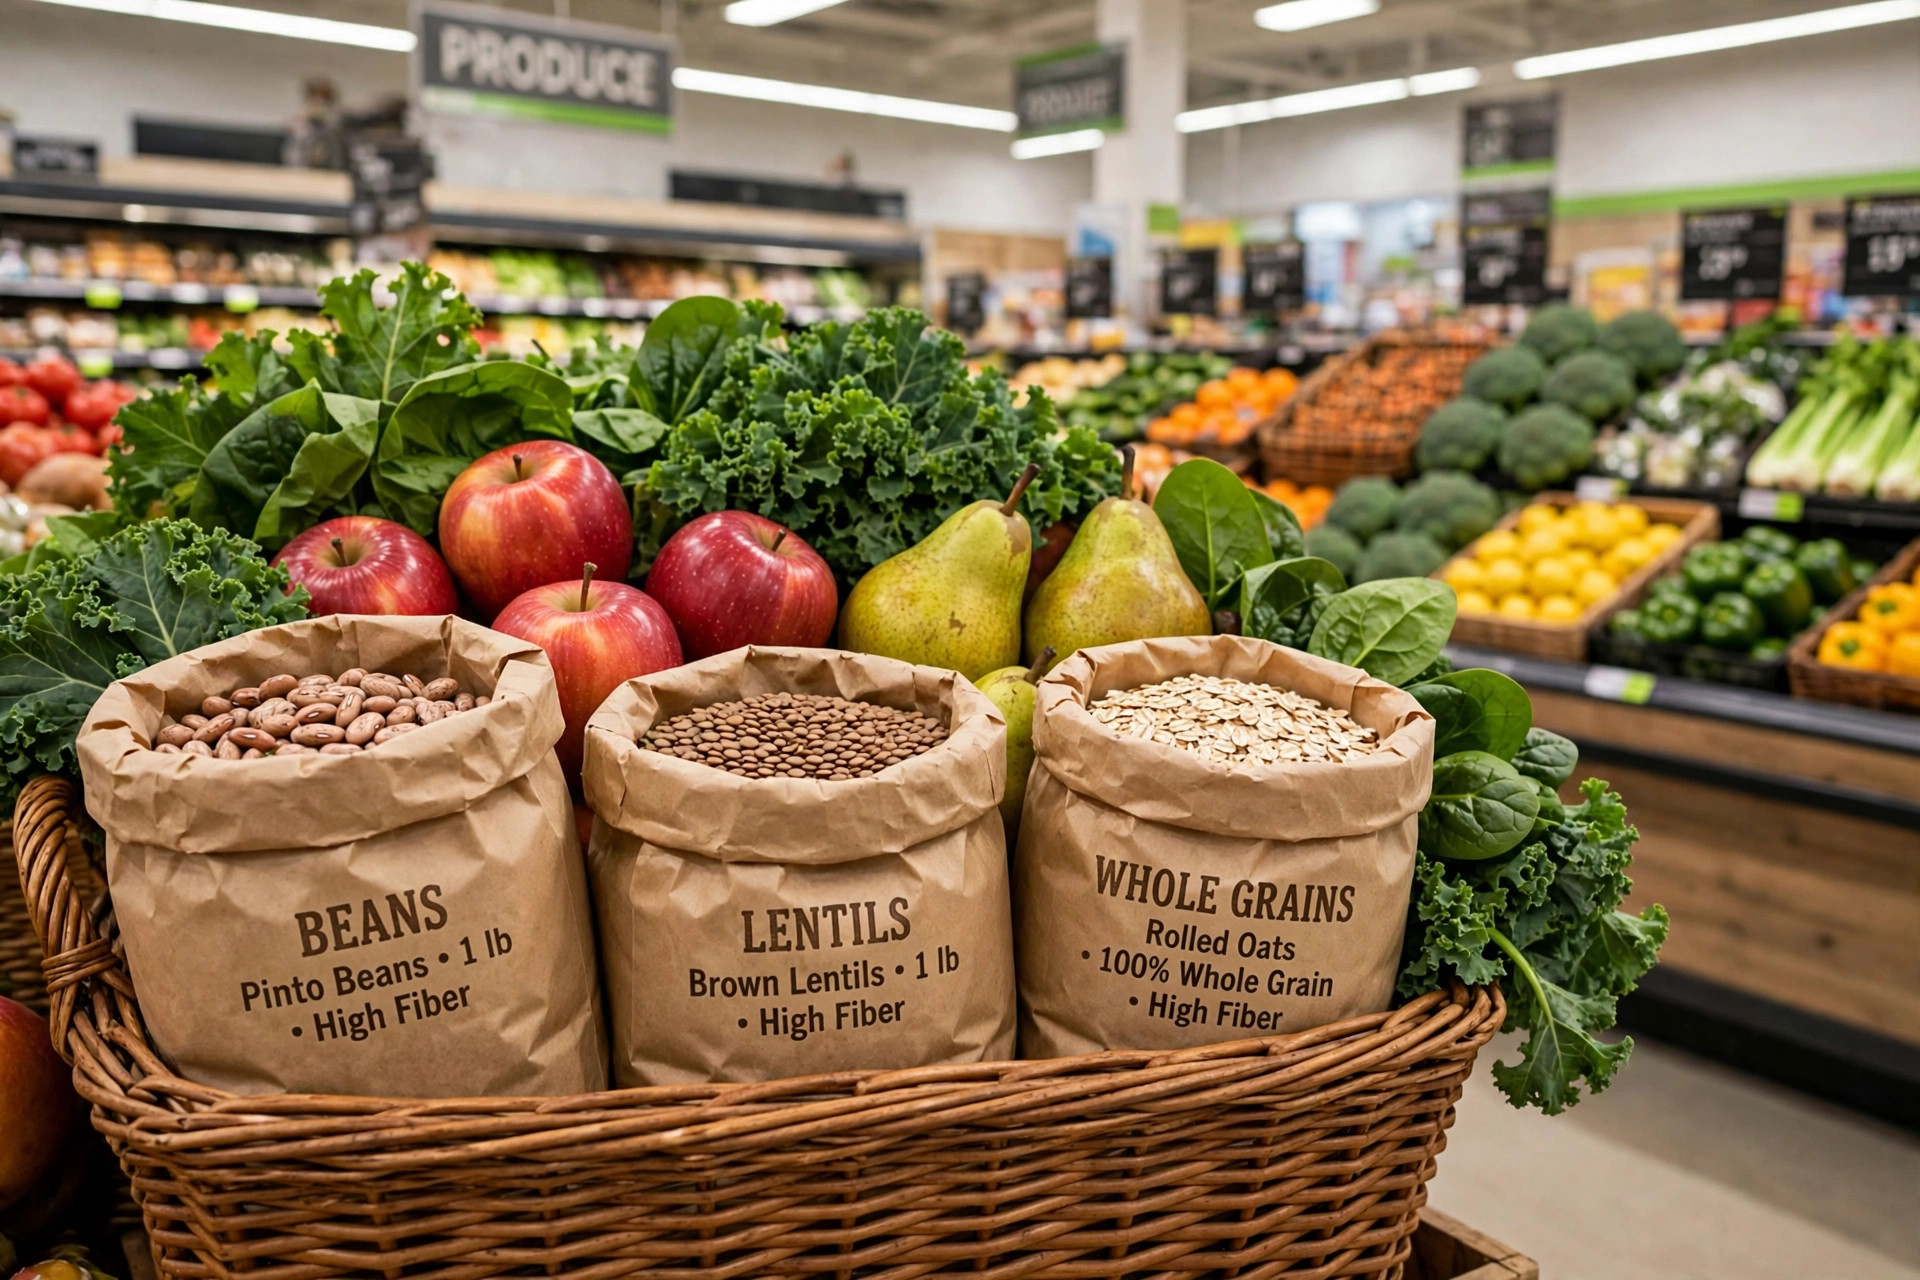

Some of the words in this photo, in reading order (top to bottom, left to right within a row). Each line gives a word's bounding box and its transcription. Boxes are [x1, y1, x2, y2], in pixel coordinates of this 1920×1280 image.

[440, 24, 656, 107] PRODUCE
[1095, 854, 1220, 915] WHOLE
[1231, 879, 1356, 923] GRAINS
[294, 884, 449, 957] BEANS
[740, 896, 911, 954] LENTILS
[1145, 918, 1230, 956] Rolled
[1237, 931, 1296, 961] Oats
[240, 976, 325, 1012] Pinto
[332, 956, 429, 998] Beans
[459, 936, 478, 966] 1
[484, 927, 513, 959] lb
[689, 968, 780, 998] Brown
[789, 959, 885, 996] Lentils
[915, 951, 929, 980] 1
[937, 944, 960, 975] lb
[1099, 946, 1170, 984] 100%
[1180, 960, 1259, 994] Whole
[1267, 969, 1333, 997] Grain
[313, 1002, 387, 1042] High
[393, 985, 470, 1025] Fiber
[759, 1004, 825, 1042] High
[835, 999, 906, 1031] Fiber
[1148, 991, 1208, 1028] High
[1216, 1000, 1284, 1031] Fiber
